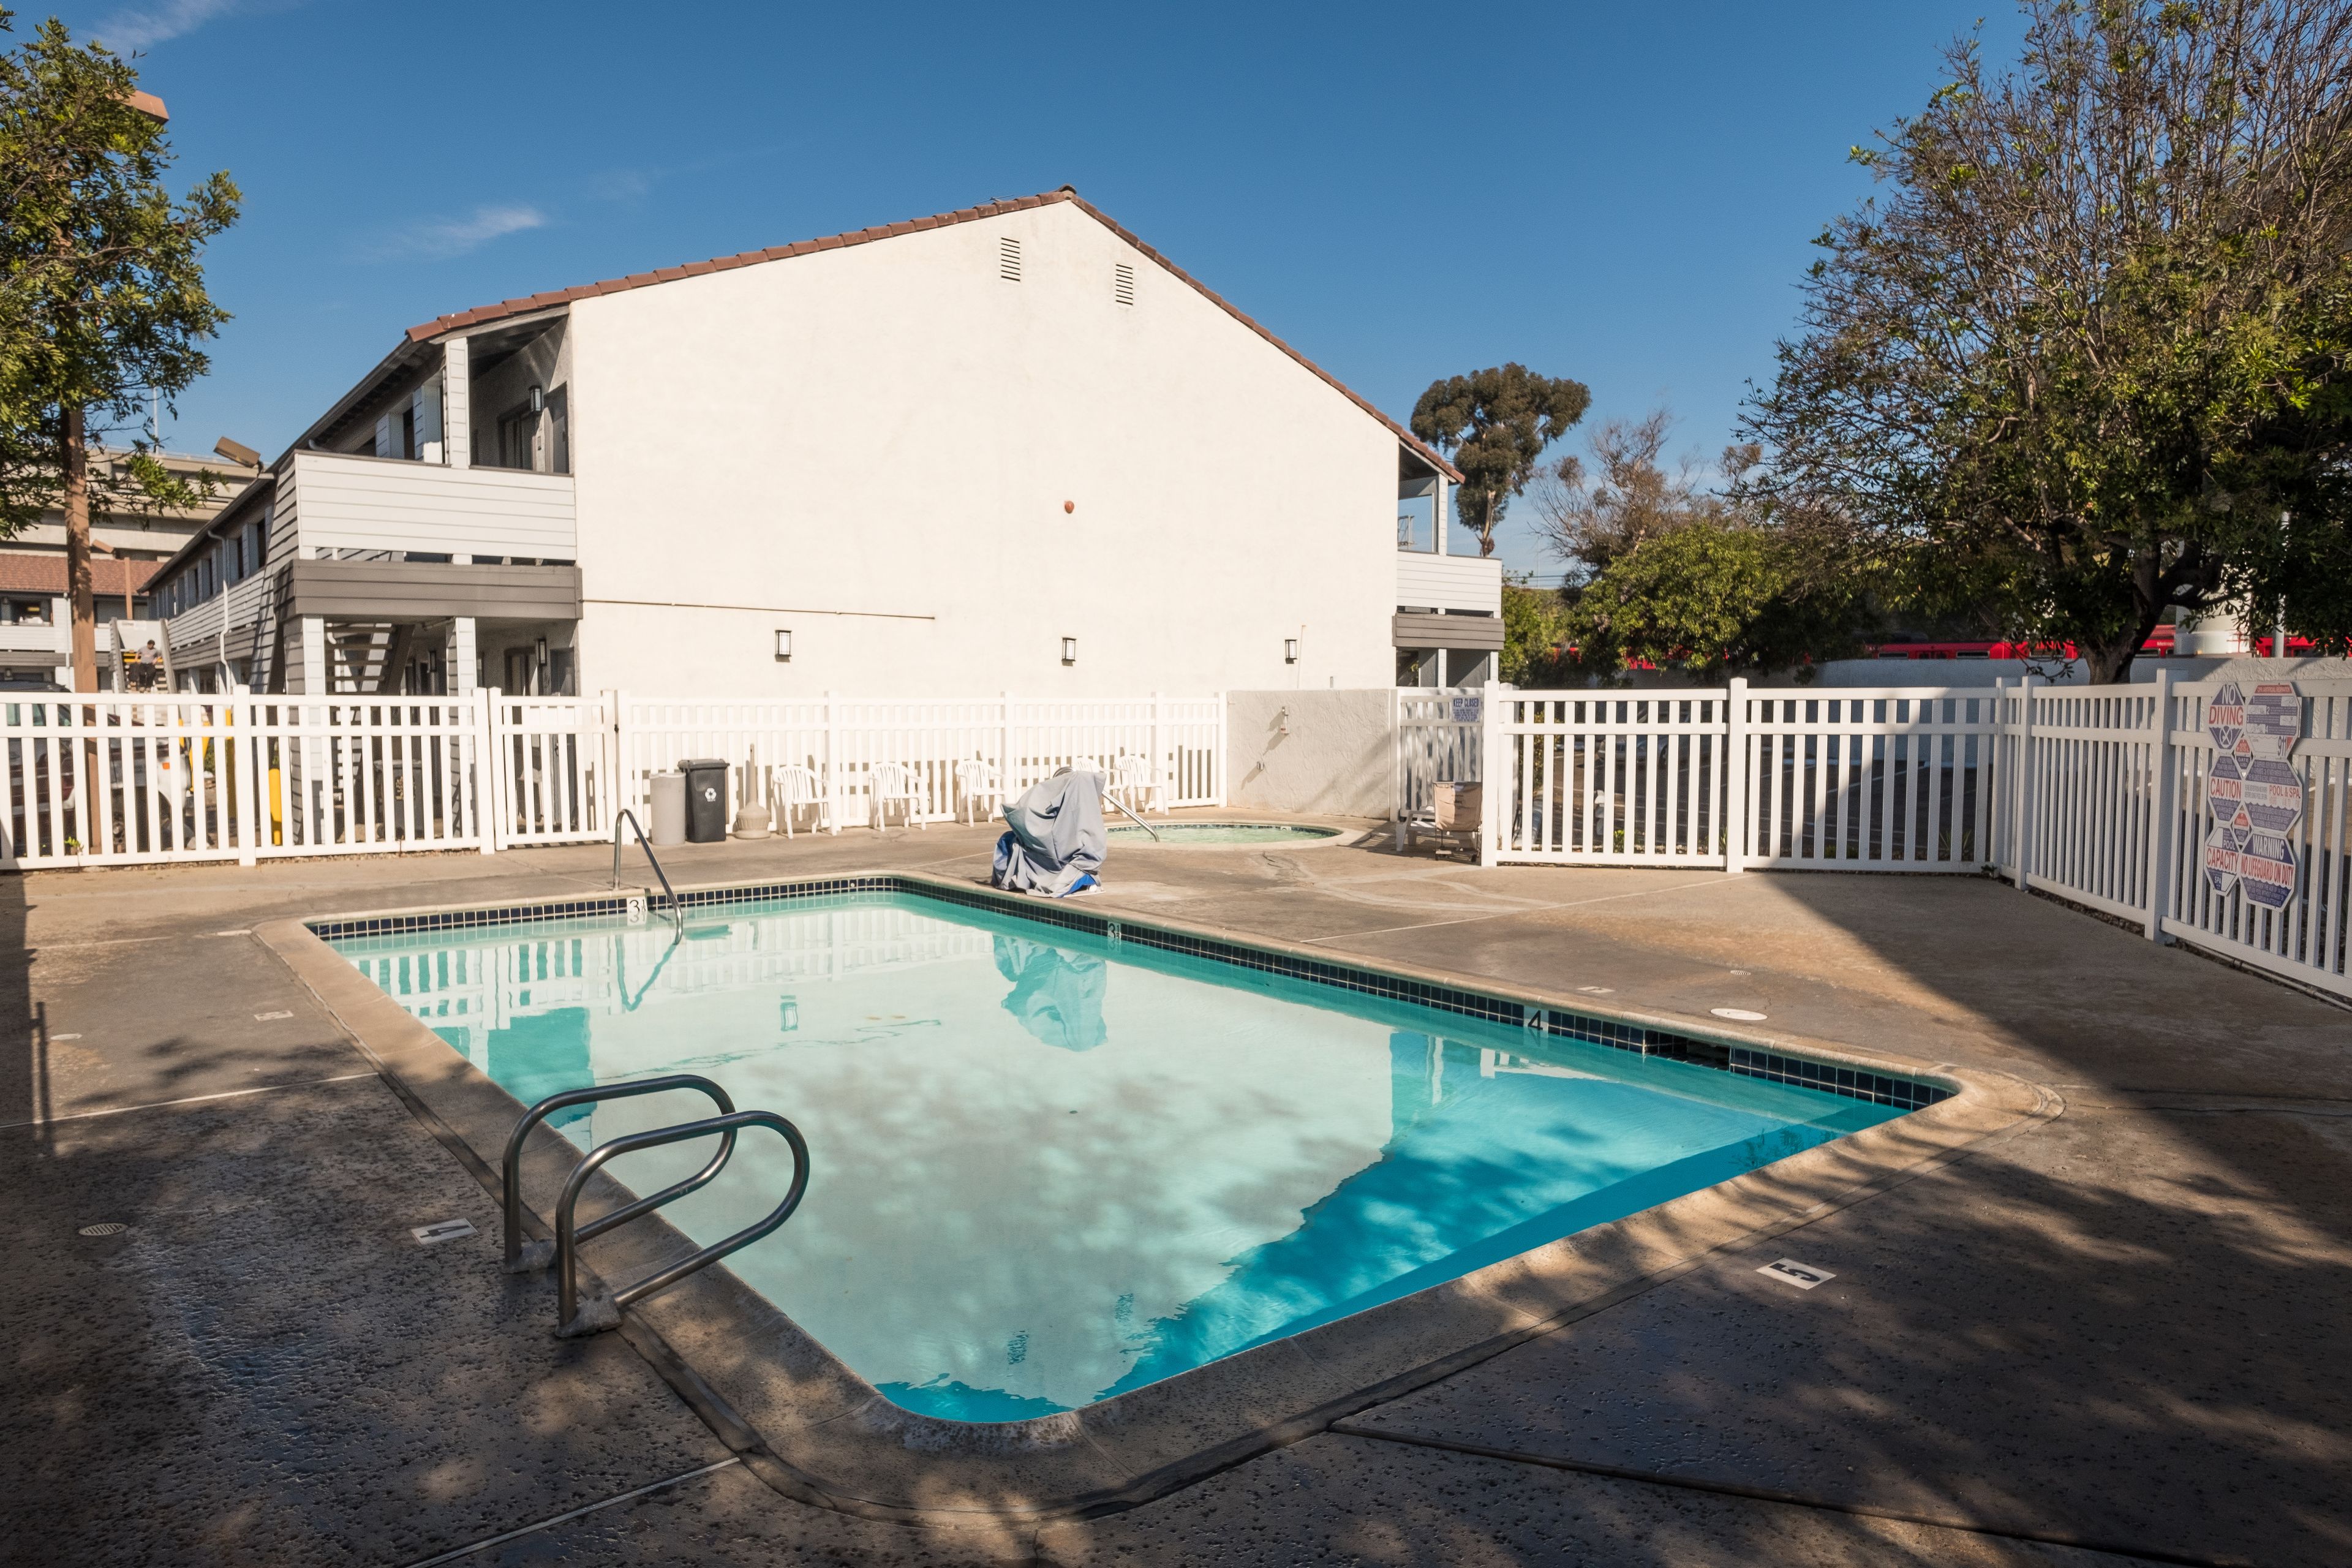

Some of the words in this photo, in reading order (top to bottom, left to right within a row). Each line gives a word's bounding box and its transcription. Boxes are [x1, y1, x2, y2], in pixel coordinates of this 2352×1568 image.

[1453, 698, 1463, 707] KEEP
[1464, 698, 1479, 707] CLOSED
[2222, 685, 2236, 705] NO
[2209, 706, 2244, 726] DIVING
[2278, 736, 2286, 756] 911
[2210, 778, 2241, 799] CAUTION
[2269, 785, 2283, 796] POOL
[2285, 787, 2288, 797] &
[2289, 788, 2300, 798] SPA
[2223, 840, 2236, 850] POOL
[2252, 834, 2285, 861] WARNING
[2206, 848, 2239, 872] CAPACITY
[2241, 855, 2248, 874] NO
[2248, 857, 2273, 881] LIFEGUARD
[2274, 864, 2281, 883] ON
[2282, 865, 2294, 886] DUTY
[1528, 1010, 1544, 1030] 4
[1769, 1262, 1820, 1282] 5
